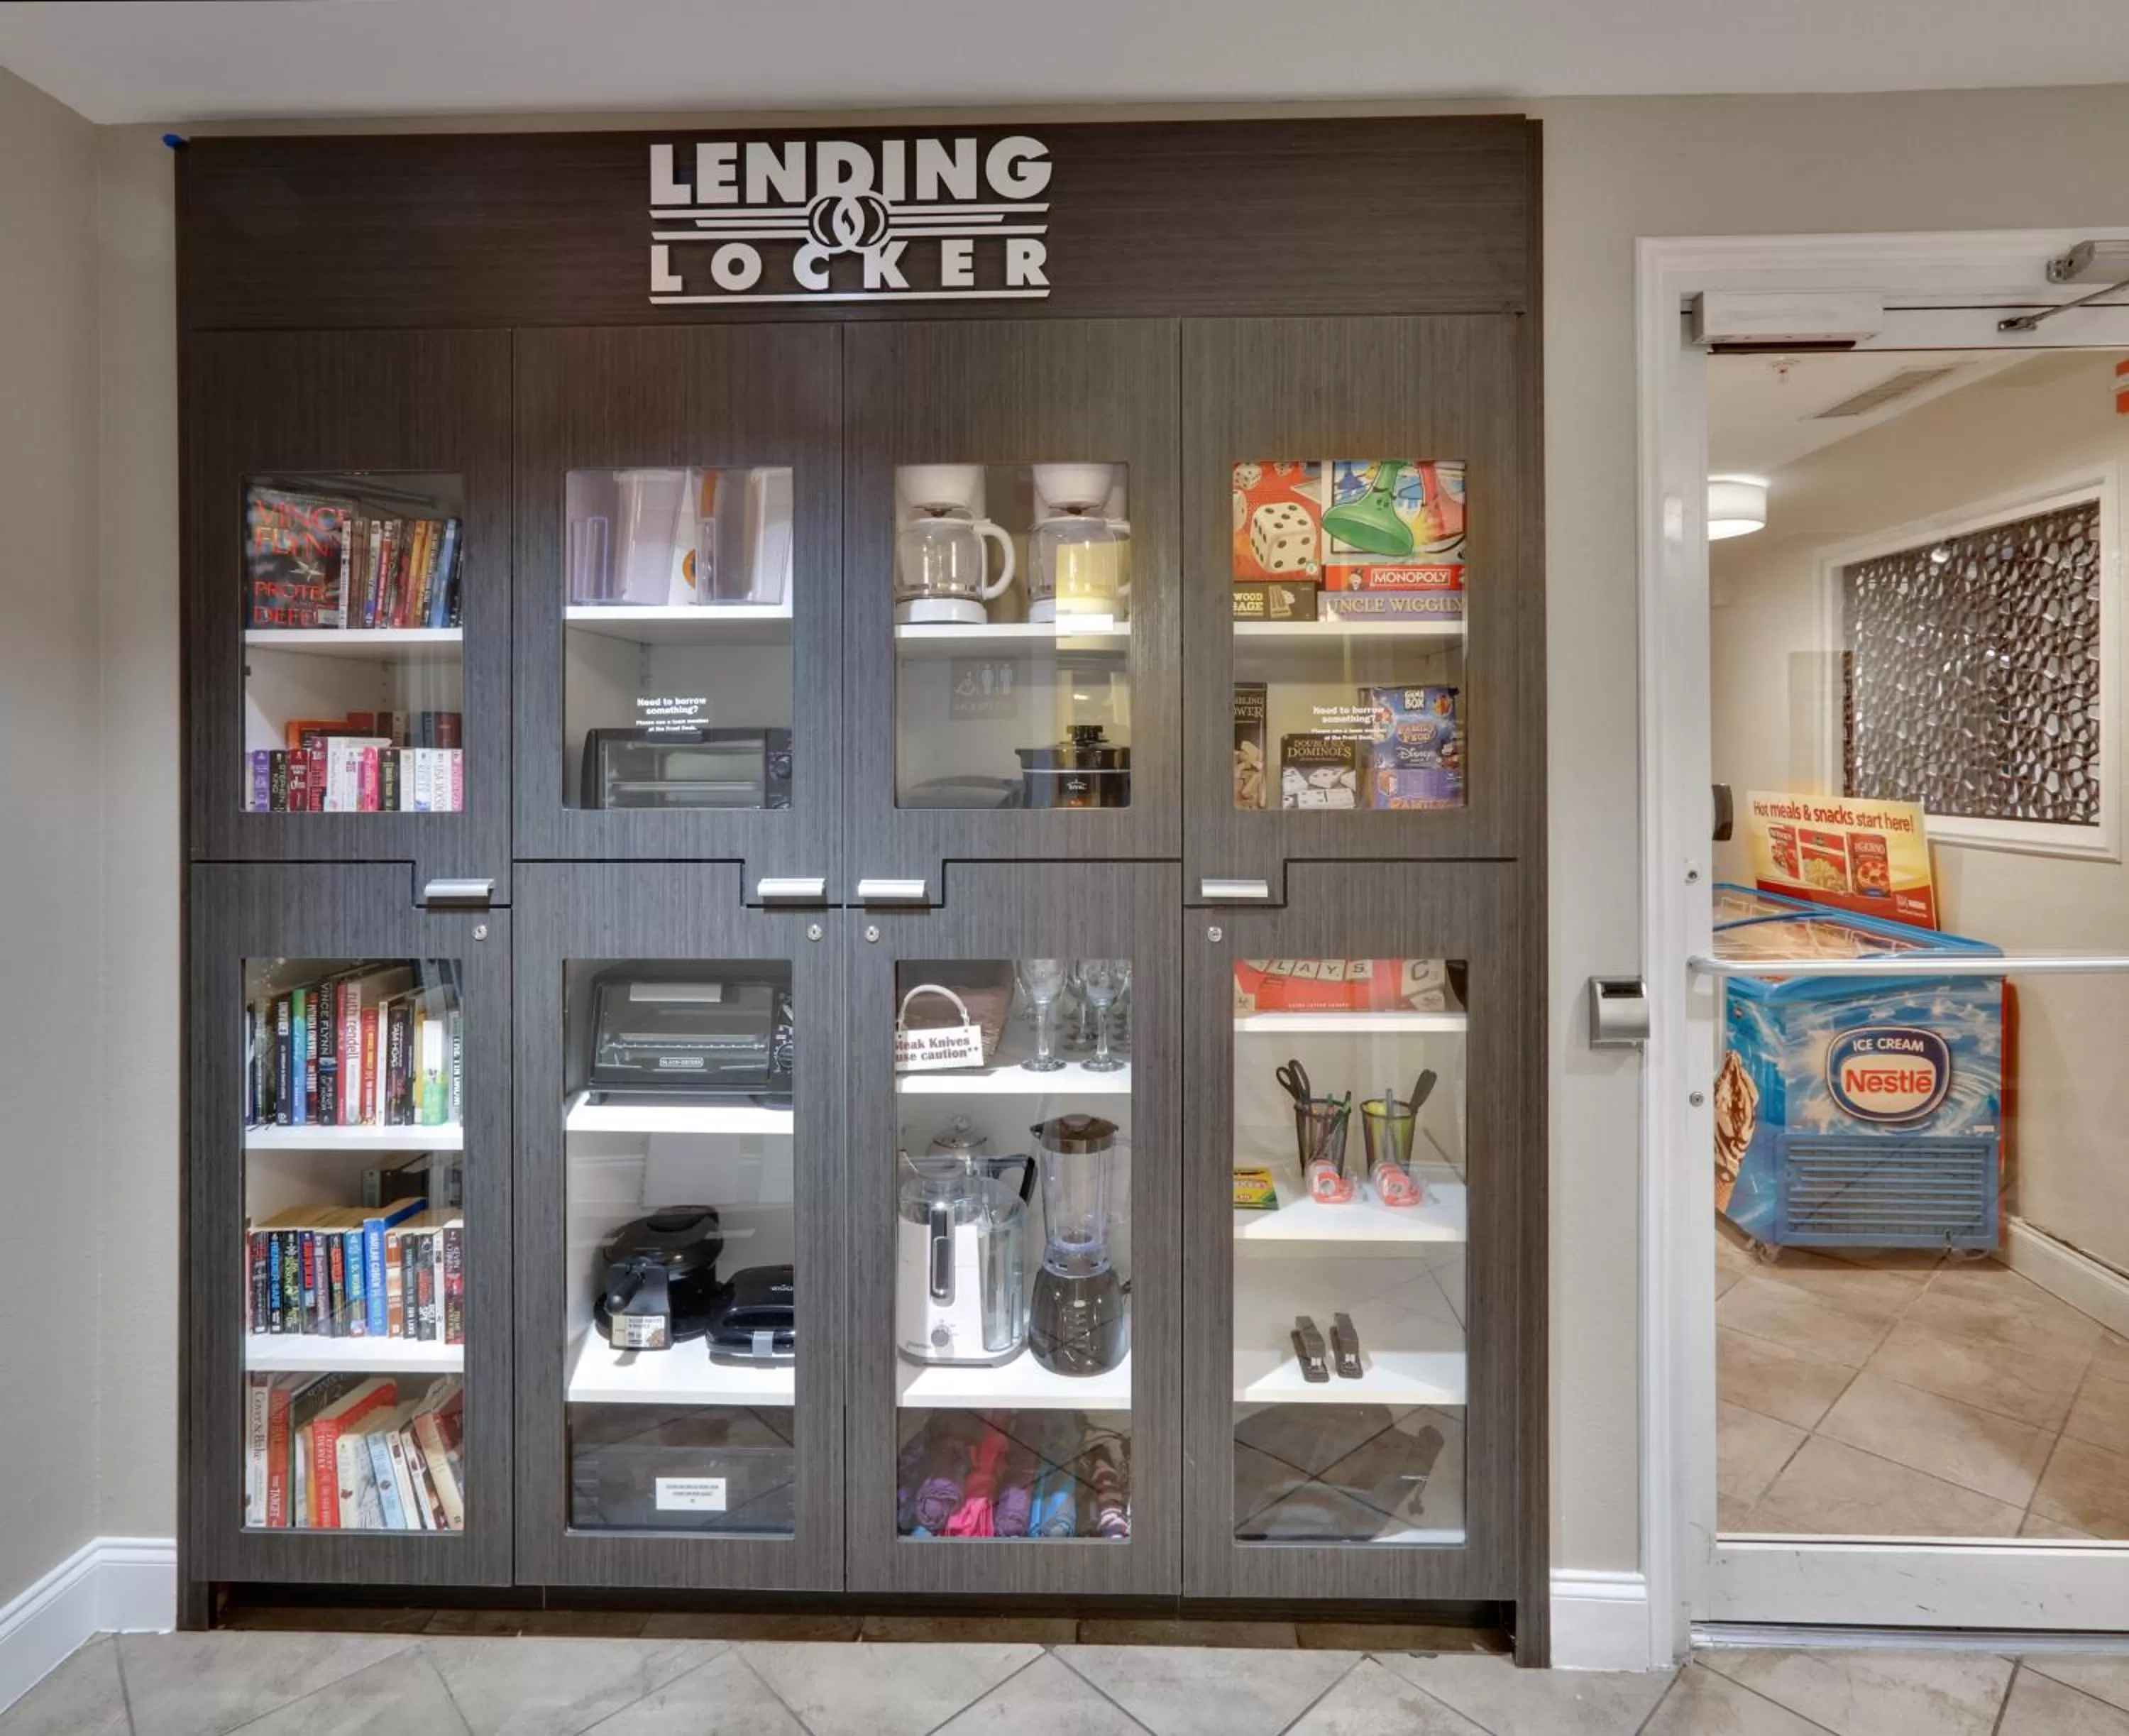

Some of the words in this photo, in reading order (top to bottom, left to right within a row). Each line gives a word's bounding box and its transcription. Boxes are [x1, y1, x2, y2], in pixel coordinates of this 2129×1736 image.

[650, 136, 1052, 204] LENDING
[651, 238, 1050, 292] LOCKER
[1375, 571, 1448, 584] MONOPOLY
[1325, 598, 1386, 613] UNCLE
[637, 698, 661, 707] Need
[663, 698, 673, 706] to
[675, 697, 707, 705] borrow
[646, 705, 699, 715] something?
[1313, 706, 1338, 715] Need
[1352, 705, 1385, 714] borrow
[1322, 715, 1375, 725] something?
[1287, 747, 1352, 759] DOMINOES
[1754, 800, 1768, 817] Hot
[1769, 801, 1801, 820] meals
[1803, 804, 1811, 821] &
[1813, 805, 1854, 825] snacks
[1856, 813, 1883, 830] start
[1884, 811, 1915, 834] here!
[320, 982, 330, 1017] VINCE
[346, 993, 358, 1016] ruth
[320, 1020, 330, 1055] FLYNN
[346, 1020, 359, 1060] rendell
[930, 1036, 970, 1048] Knives
[1853, 1038, 1874, 1053] ICE
[1877, 1038, 1924, 1053] CREAM
[1846, 1069, 1932, 1094] Nestlé
